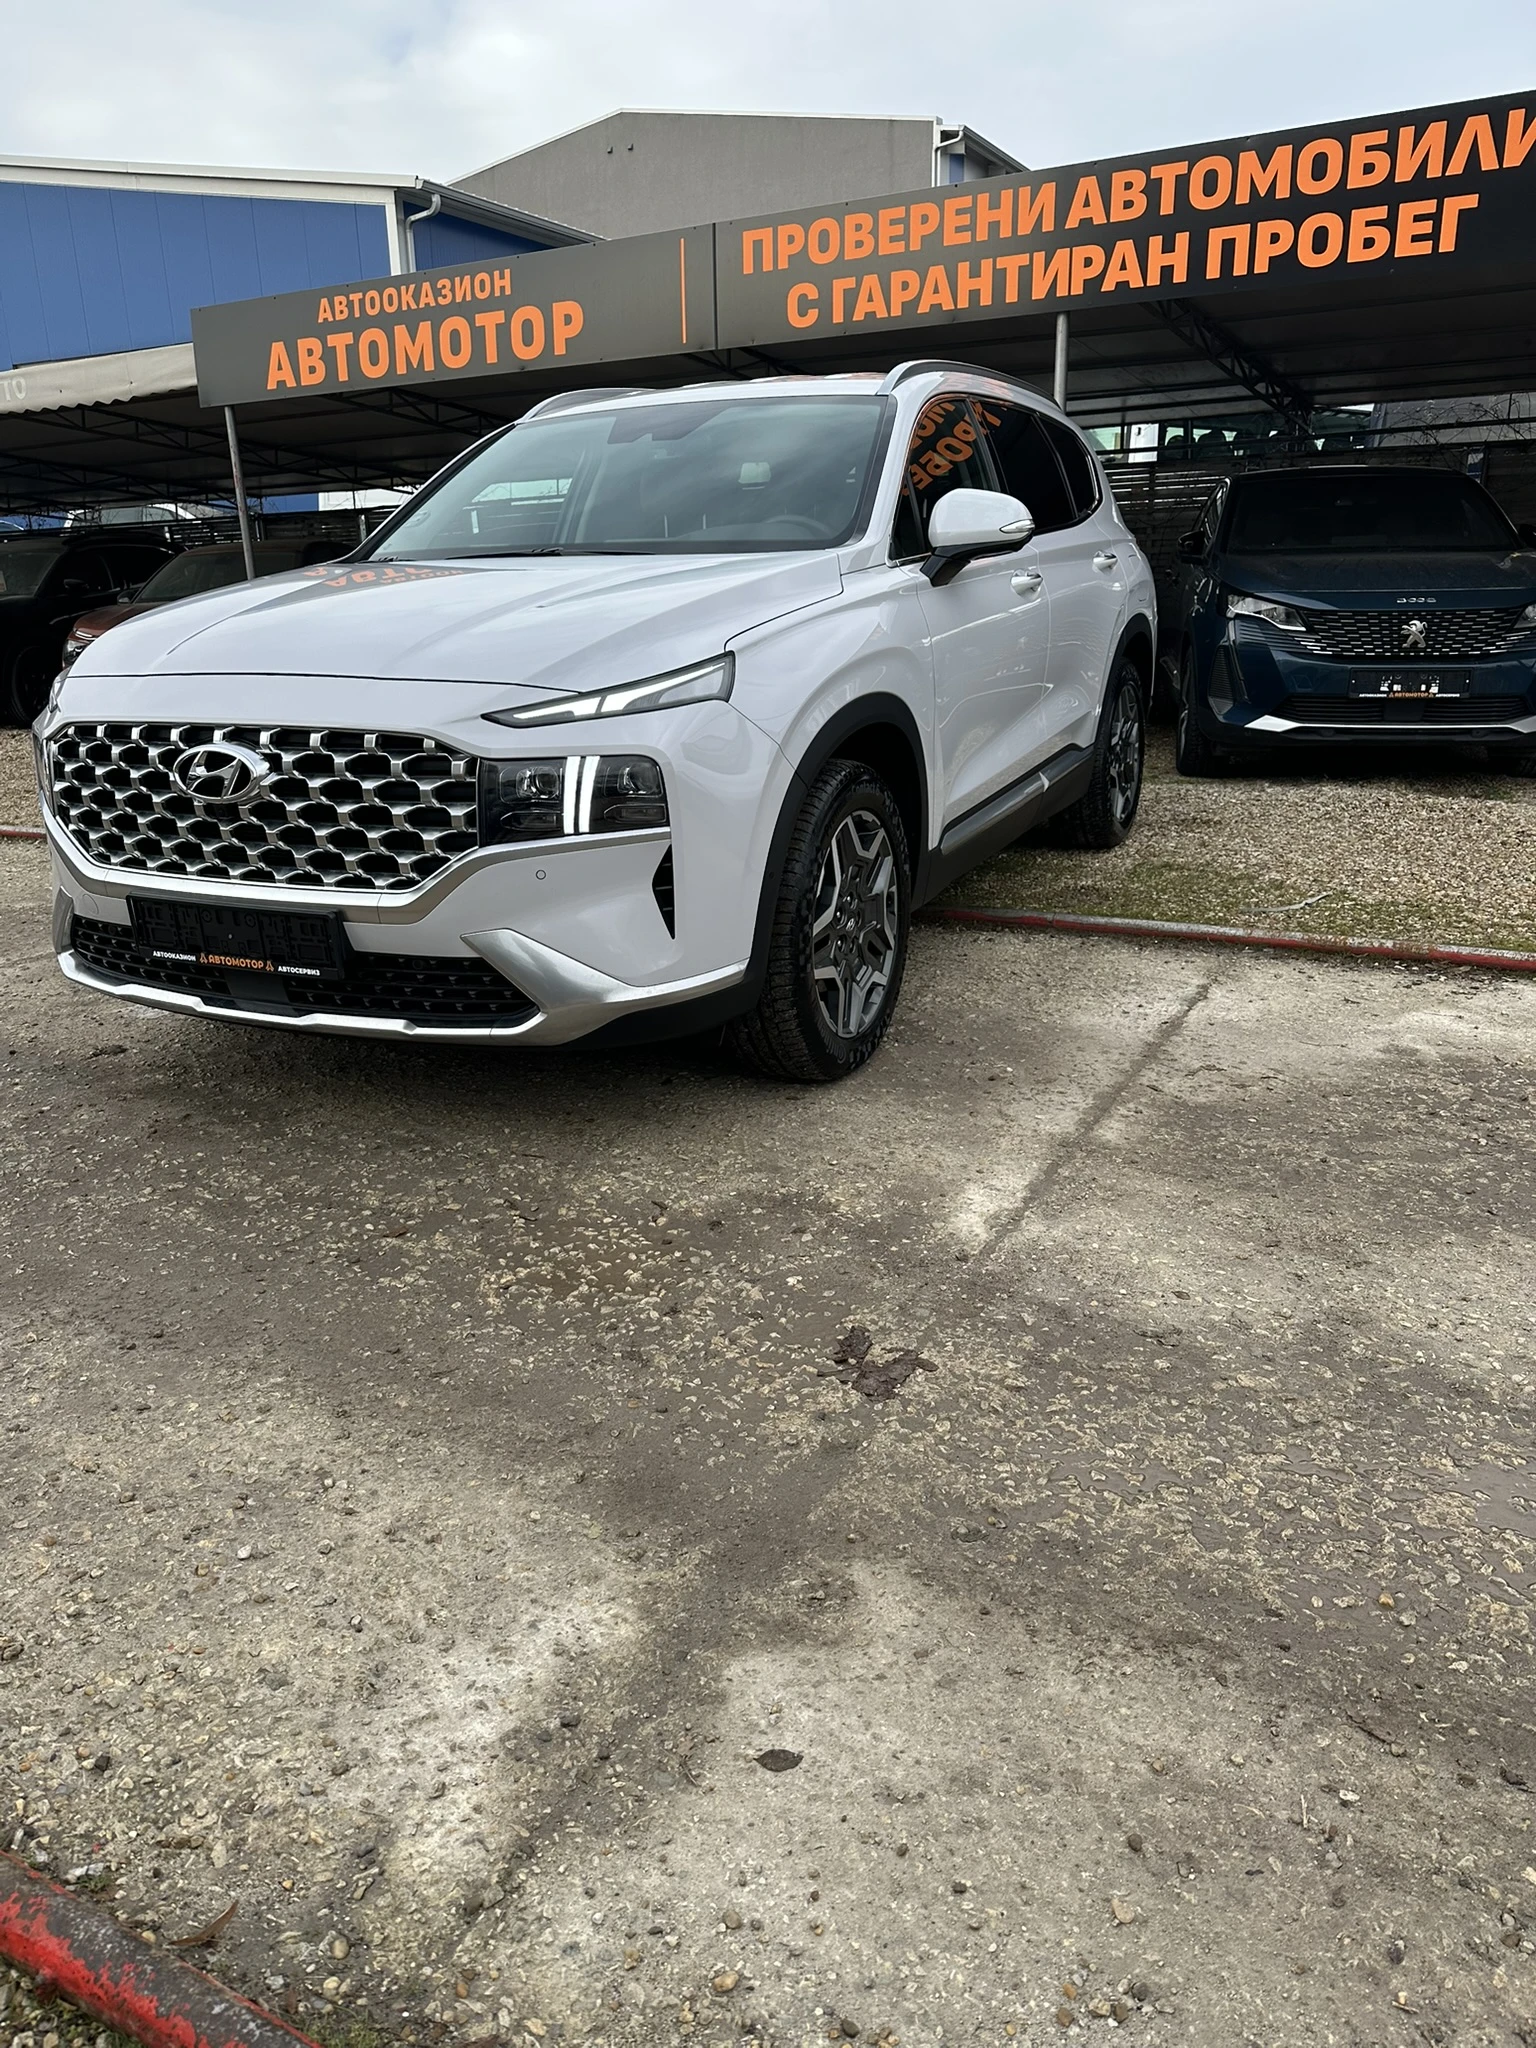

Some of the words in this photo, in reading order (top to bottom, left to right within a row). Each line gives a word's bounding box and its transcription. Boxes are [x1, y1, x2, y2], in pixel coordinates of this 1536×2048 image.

[741, 182, 1057, 275] ПРОВЕРЕНИ
[1064, 109, 1536, 230] АВТОМОБИЛИ
[317, 269, 512, 323] АВТООКАЗИОН
[786, 283, 820, 329] С
[831, 232, 1190, 325] ГАРАНТИРАН
[1205, 194, 1480, 280] ПРОБЕГ
[266, 301, 585, 391] АВТОМОТОР
[152, 950, 197, 962] АВТООКАЗИОН
[208, 954, 265, 970] АВТОМОТОР
[277, 965, 321, 977] АВТОСЕРВИЗ
